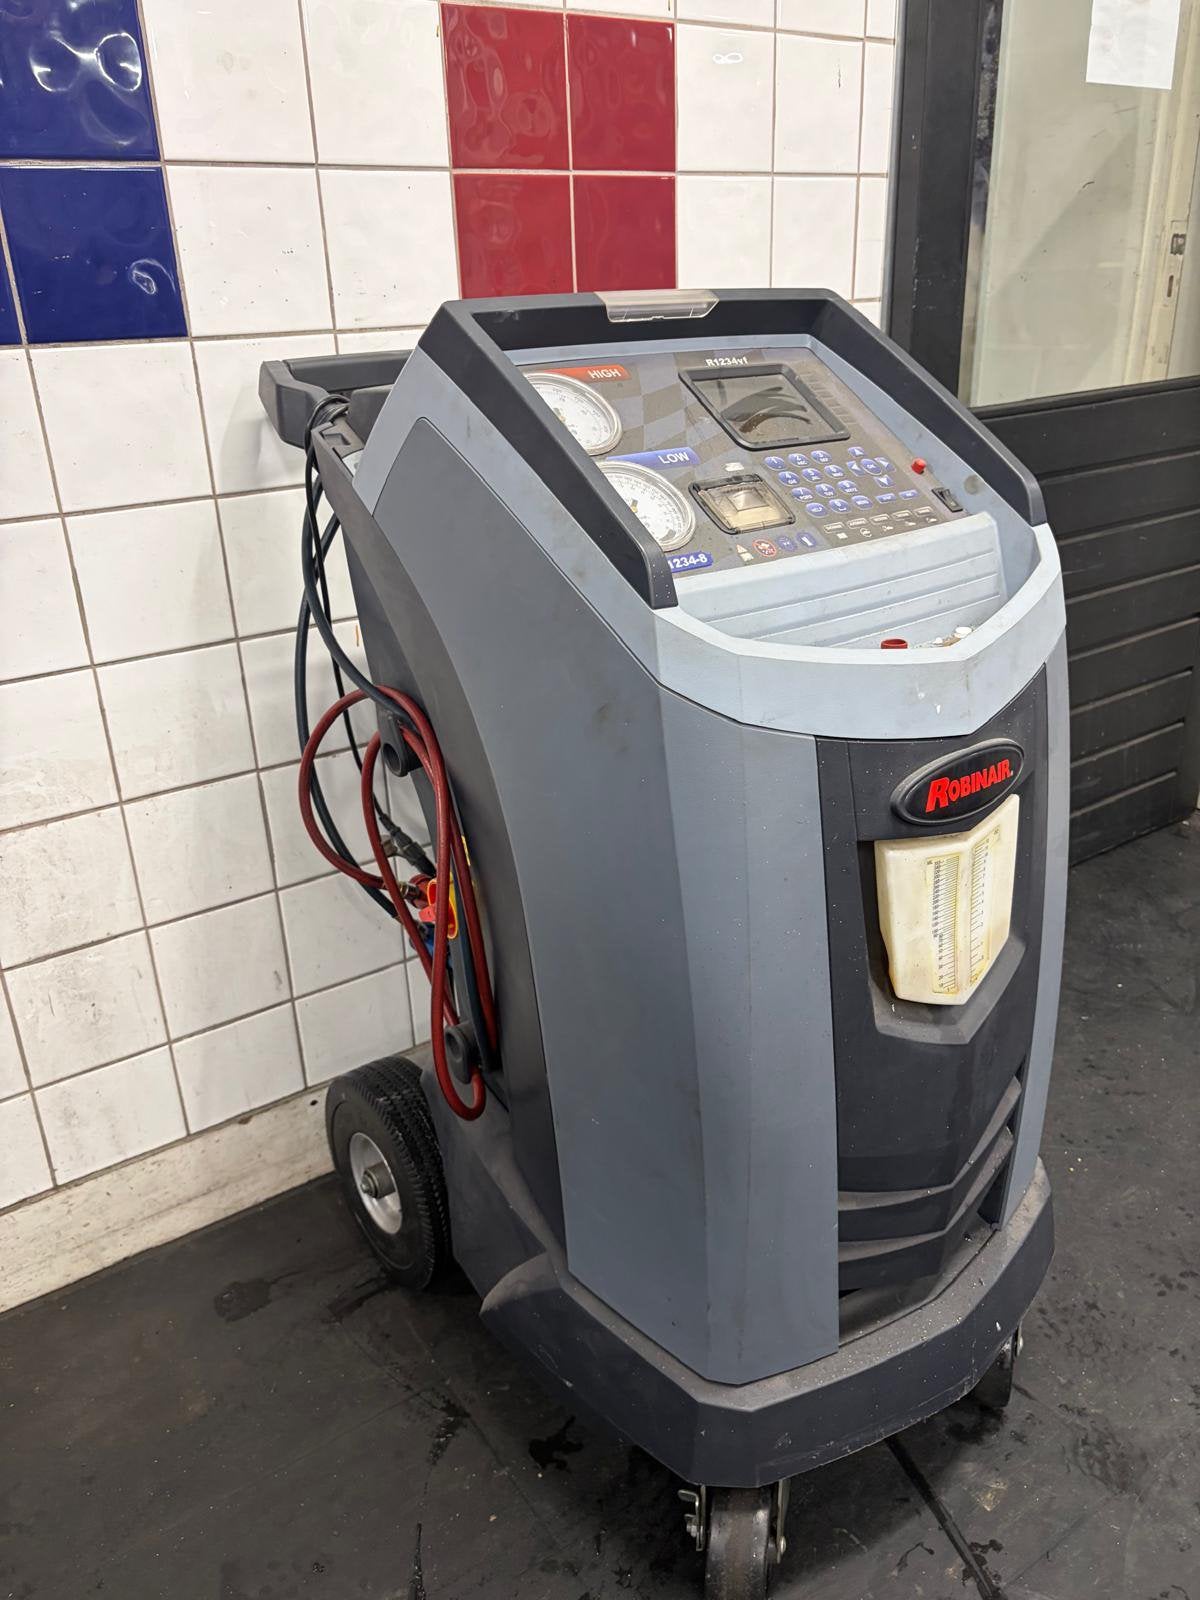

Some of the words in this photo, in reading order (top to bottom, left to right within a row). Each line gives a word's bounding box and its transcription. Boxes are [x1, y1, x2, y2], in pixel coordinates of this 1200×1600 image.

[587, 368, 622, 379] HIGH
[658, 451, 690, 464] LOW
[925, 759, 1011, 813] ROBINAIR
